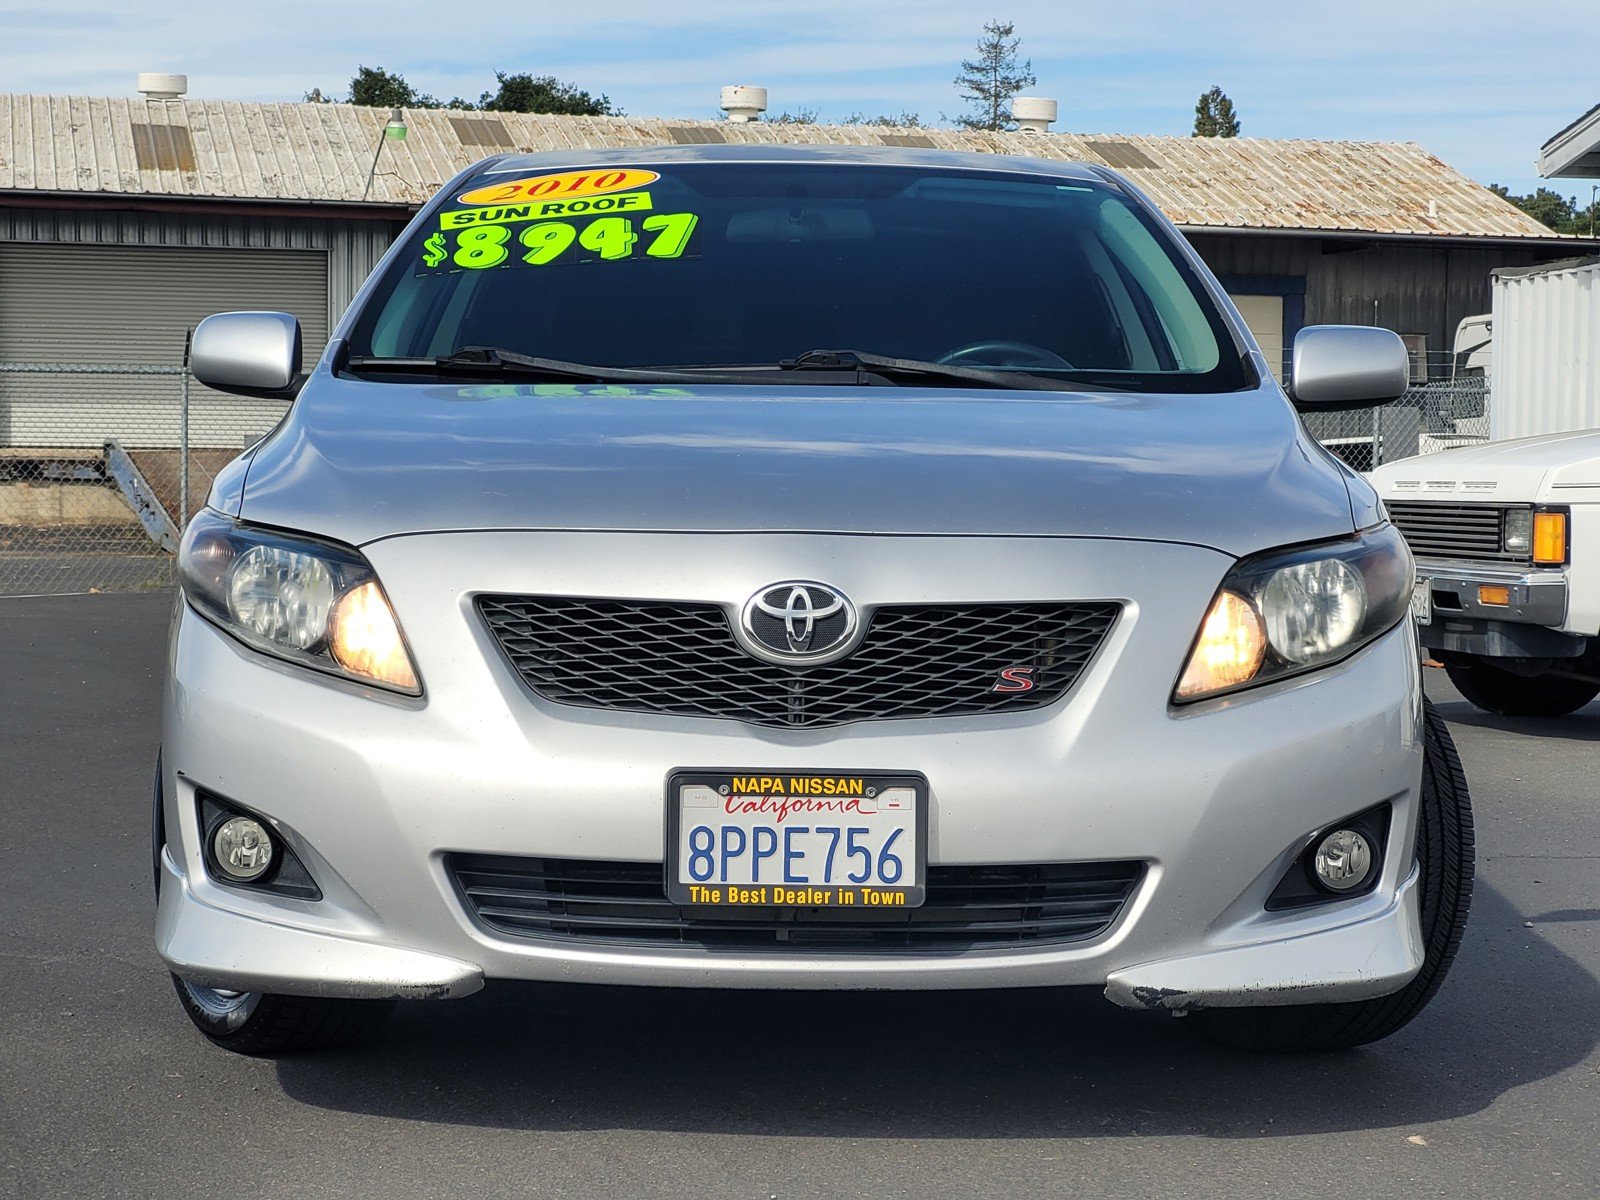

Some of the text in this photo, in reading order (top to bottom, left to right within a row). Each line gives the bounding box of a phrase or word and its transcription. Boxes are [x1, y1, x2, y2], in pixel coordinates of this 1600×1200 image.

[488, 172, 627, 201] 2010
[452, 196, 639, 225] SUN ROOF
[422, 213, 699, 269] $8947
[992, 667, 1034, 692] S
[732, 777, 863, 795] NAPA NISSAN
[724, 795, 877, 823] California
[688, 825, 904, 884] 8PPE756
[690, 886, 905, 905] The Best Dealer in Town
